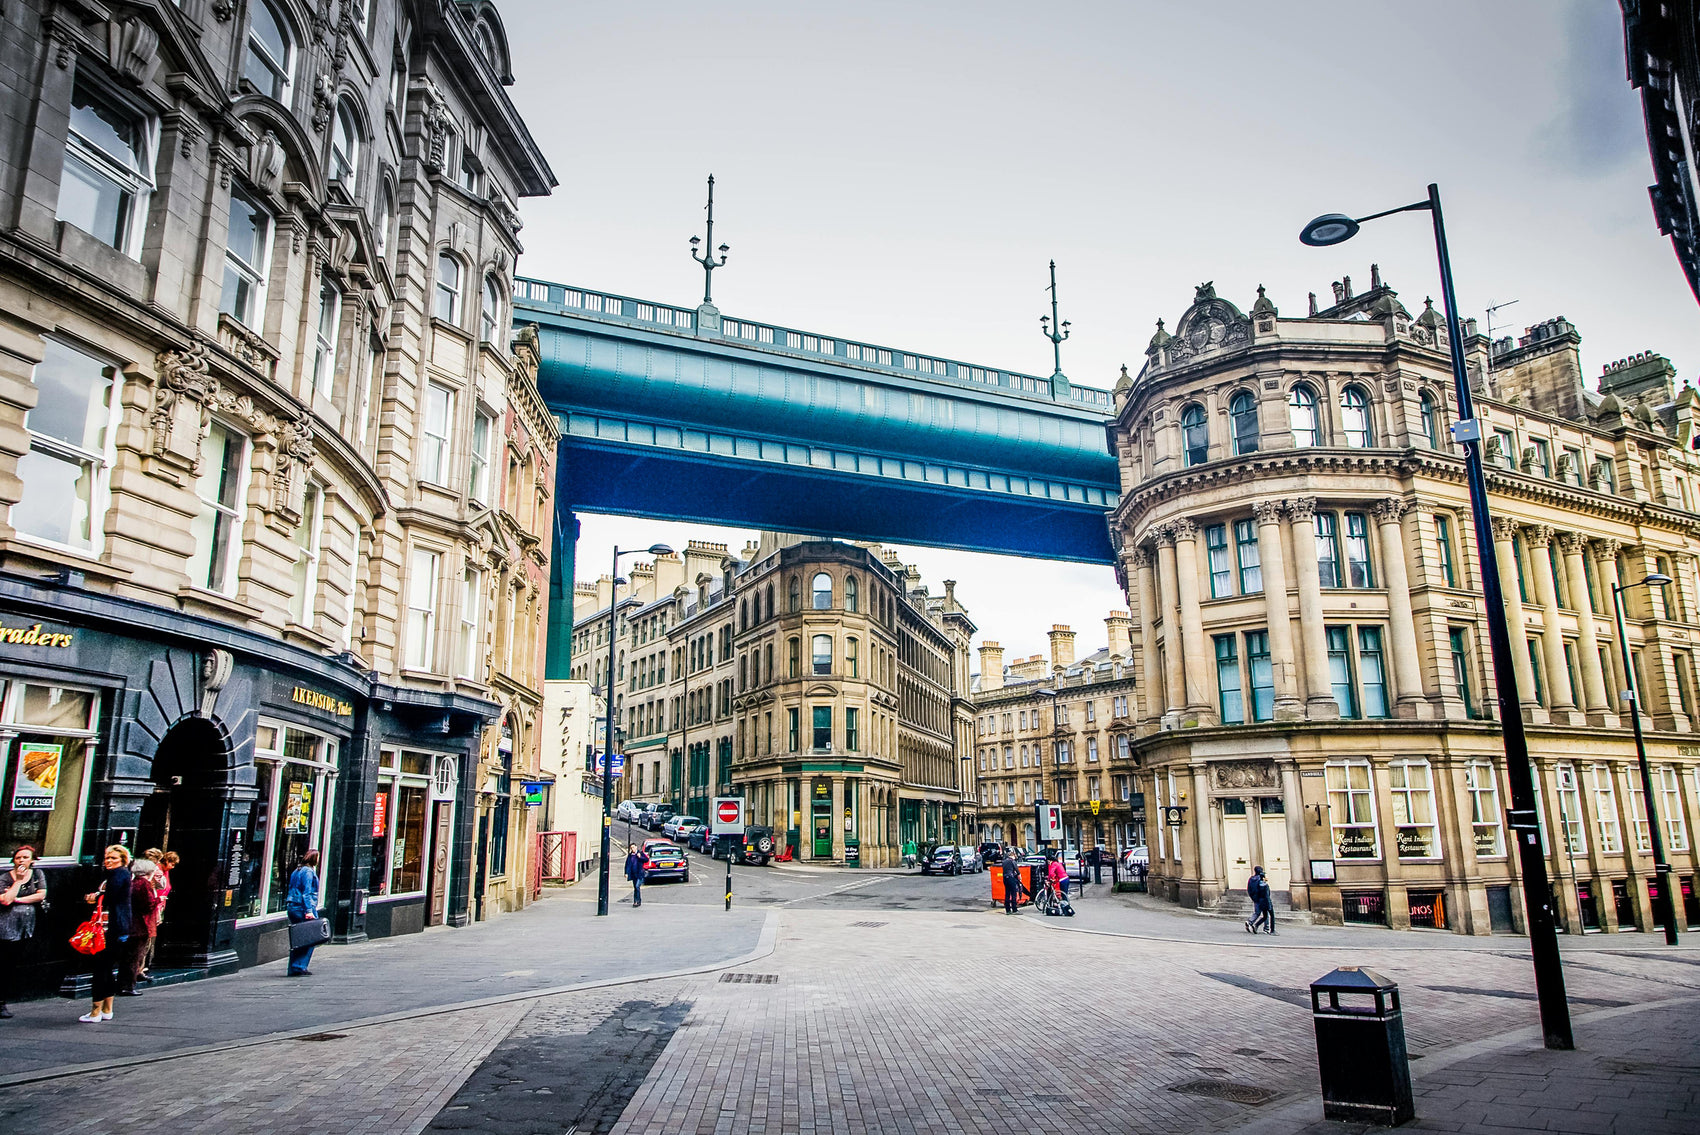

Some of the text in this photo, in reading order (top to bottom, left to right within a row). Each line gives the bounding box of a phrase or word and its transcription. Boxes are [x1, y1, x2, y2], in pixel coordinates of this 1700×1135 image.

[0, 621, 73, 648] raders
[292, 686, 336, 713] AKENSIDE
[16, 798, 34, 806] ONLY
[1336, 833, 1353, 845] Rani
[1396, 833, 1413, 844] Rani
[1340, 845, 1372, 853] Restaurant
